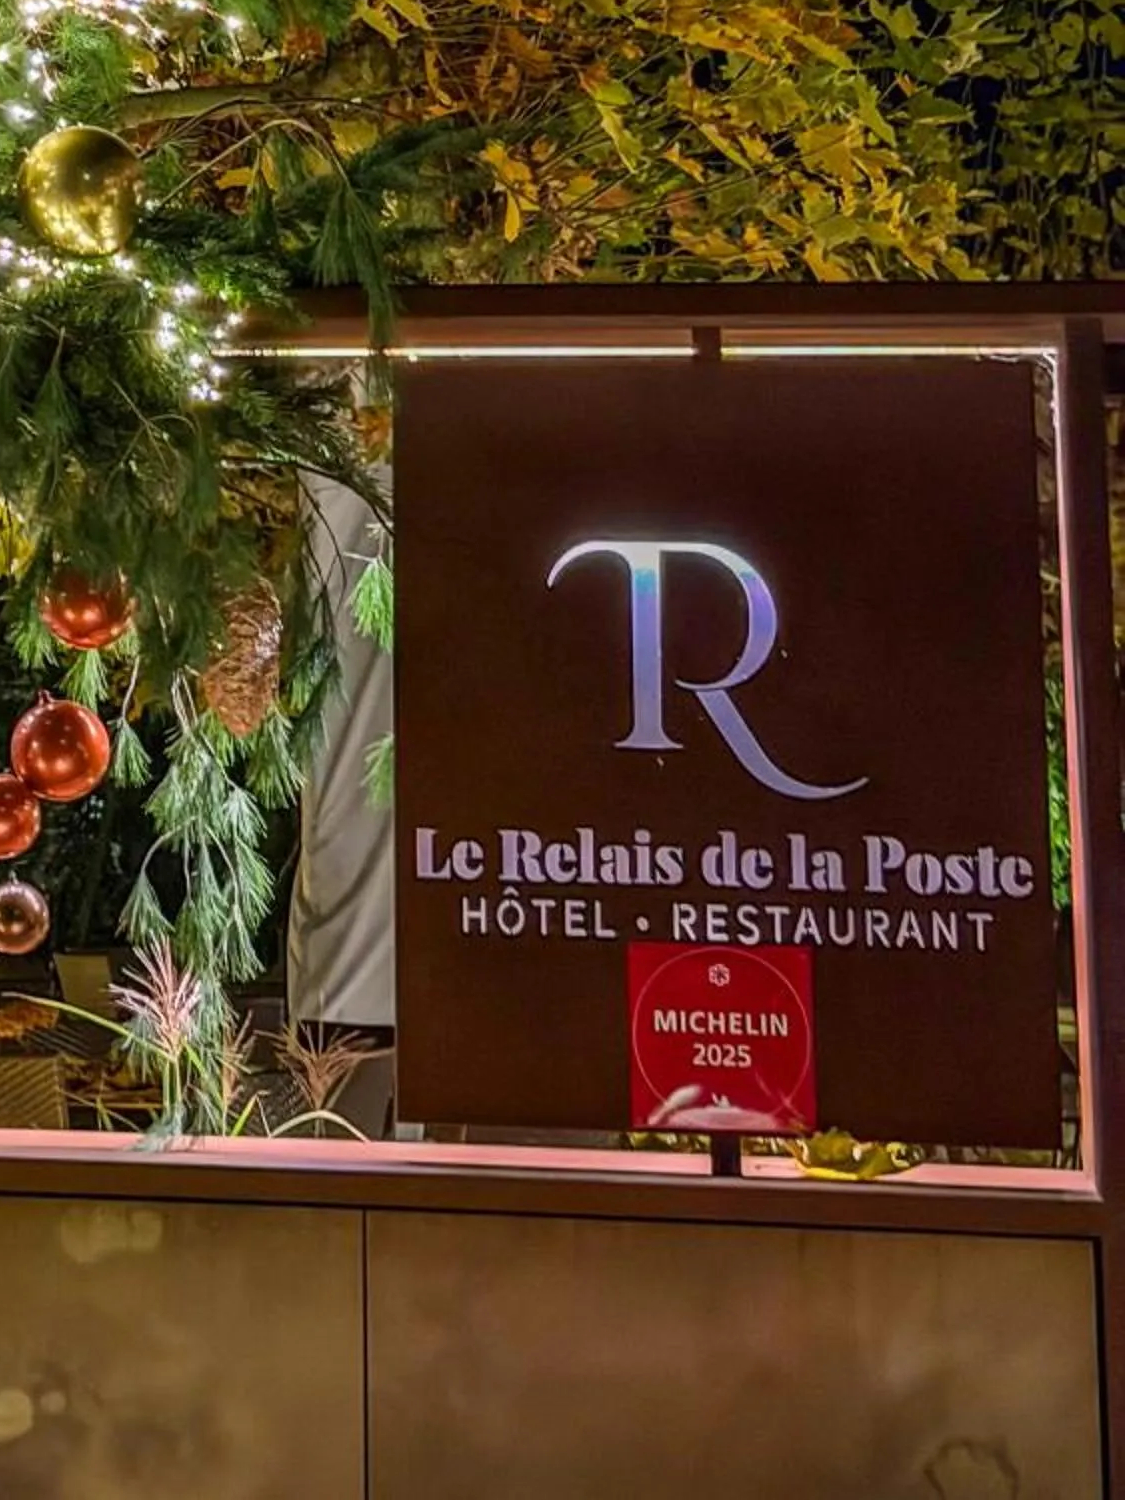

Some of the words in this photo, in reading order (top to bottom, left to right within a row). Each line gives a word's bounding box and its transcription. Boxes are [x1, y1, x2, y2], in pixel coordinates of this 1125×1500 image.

[416, 827, 484, 880] Le
[497, 827, 684, 886] Relais
[701, 830, 774, 890] de
[786, 833, 846, 891] la
[862, 835, 1034, 897] Poste
[462, 887, 617, 938] HÔTEL
[673, 902, 994, 951] RESTAURANT
[653, 1009, 789, 1037] MICHELIN
[692, 1043, 752, 1068] 2025
